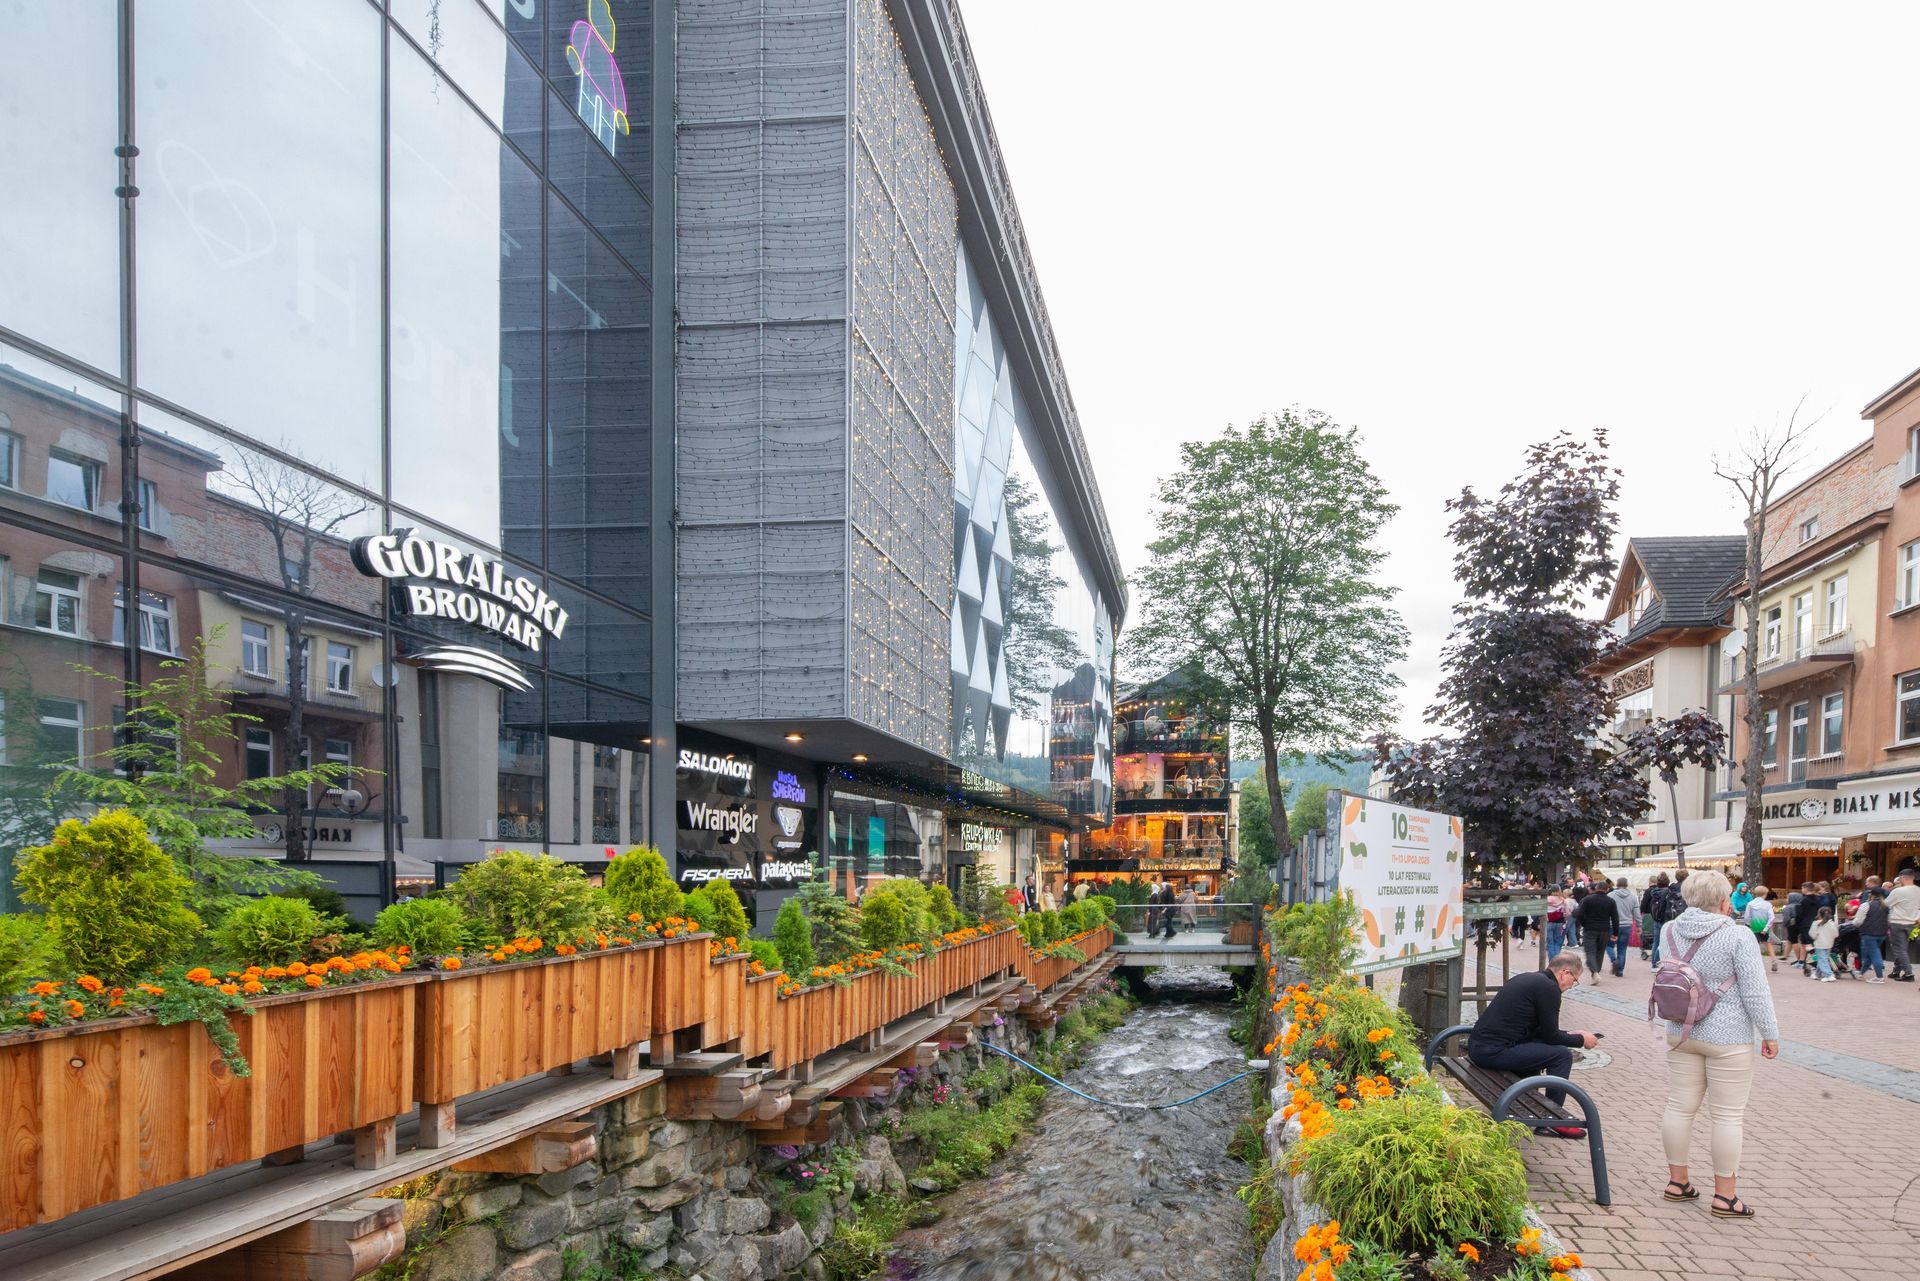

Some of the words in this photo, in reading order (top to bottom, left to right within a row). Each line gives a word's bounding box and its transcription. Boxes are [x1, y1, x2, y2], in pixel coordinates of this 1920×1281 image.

[367, 528, 569, 640] GÓRALSKI
[407, 585, 542, 652] BROWAR
[679, 750, 753, 779] SALOMON
[1763, 800, 1801, 819] ARCZ
[1833, 793, 1879, 814] BIAŁY
[687, 800, 758, 844] Wrangler
[1391, 812, 1408, 841] 10
[761, 860, 813, 881] patagonia
[1404, 855, 1416, 864] LIPCA
[681, 869, 744, 882] FISCHER
[1388, 871, 1395, 880] 10
[1395, 871, 1404, 880] LAT
[1405, 871, 1432, 881] FESTIWALU
[1378, 886, 1414, 896] LITERACKIEGO
[1415, 886, 1420, 895] W
[1421, 886, 1439, 895] KADRZE
